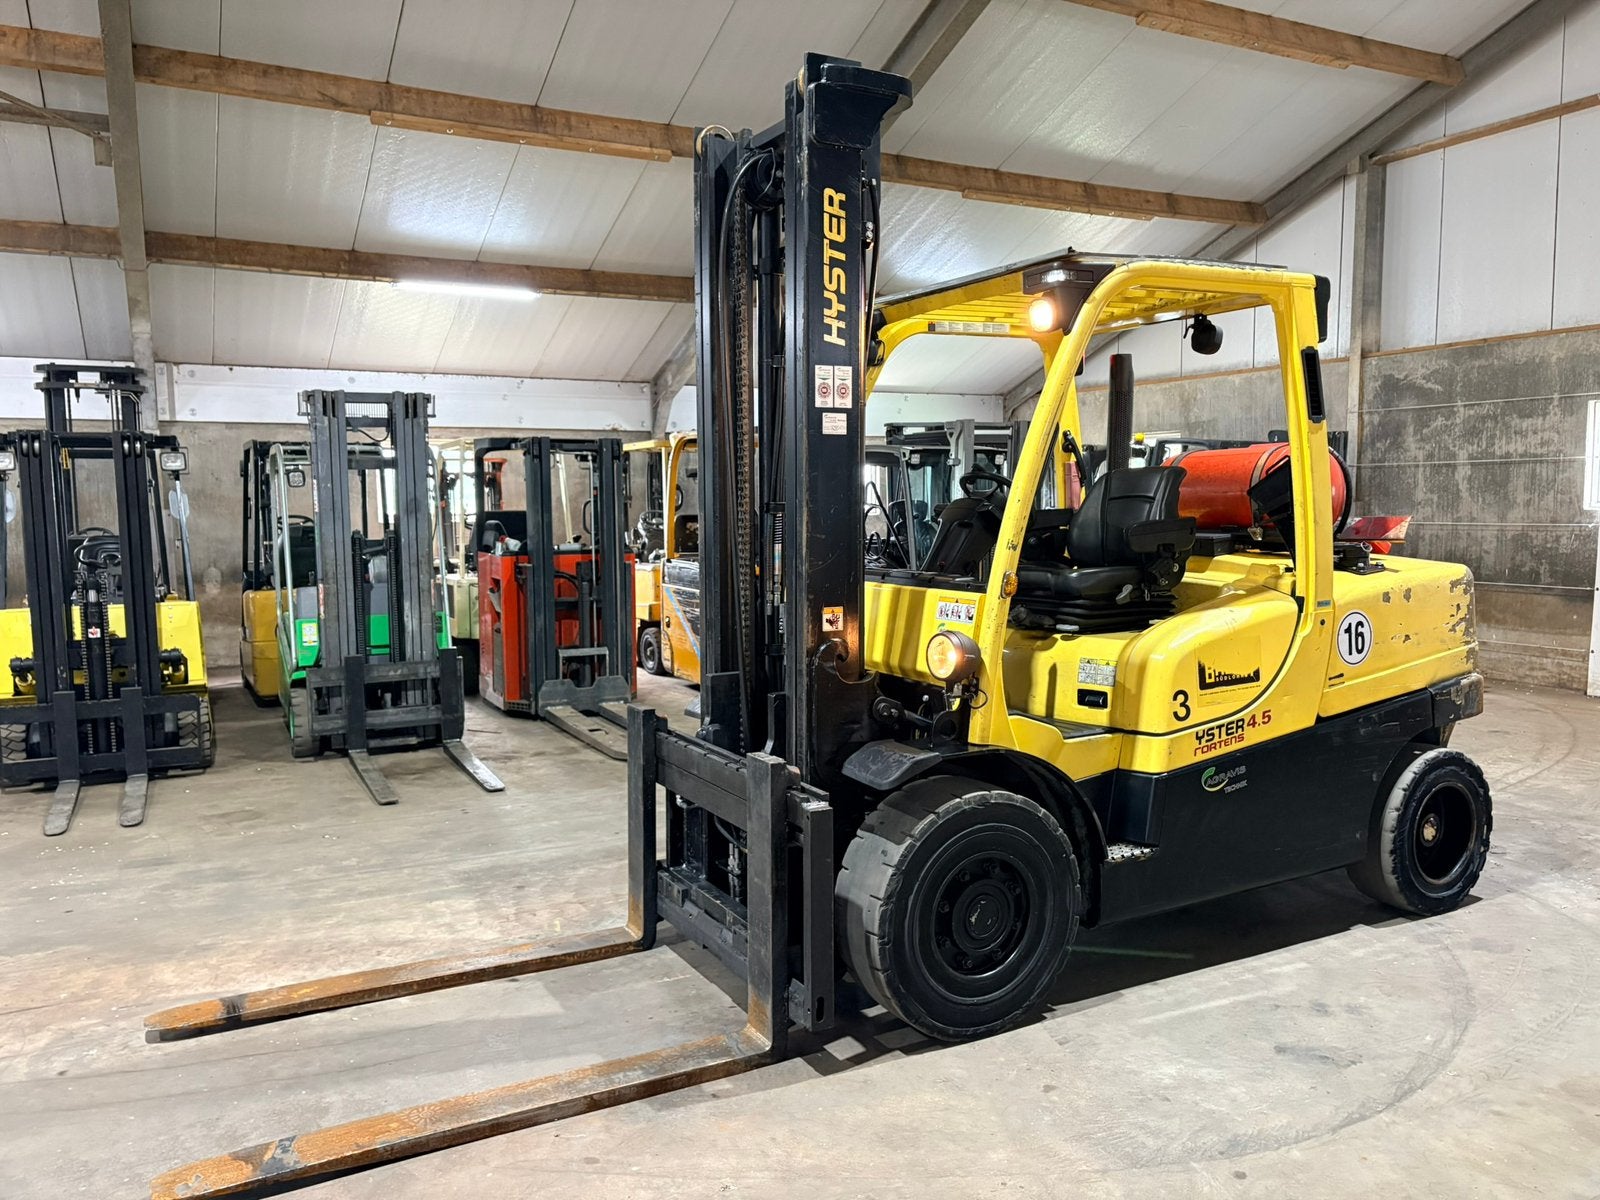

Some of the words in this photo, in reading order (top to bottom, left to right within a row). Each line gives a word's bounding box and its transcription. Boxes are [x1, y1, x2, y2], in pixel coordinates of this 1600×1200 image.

[823, 187, 846, 347] HYSTER
[1344, 620, 1365, 656] 16
[1172, 689, 1191, 722] 3
[1195, 718, 1245, 745] YSTER
[1246, 709, 1272, 728] 4.5
